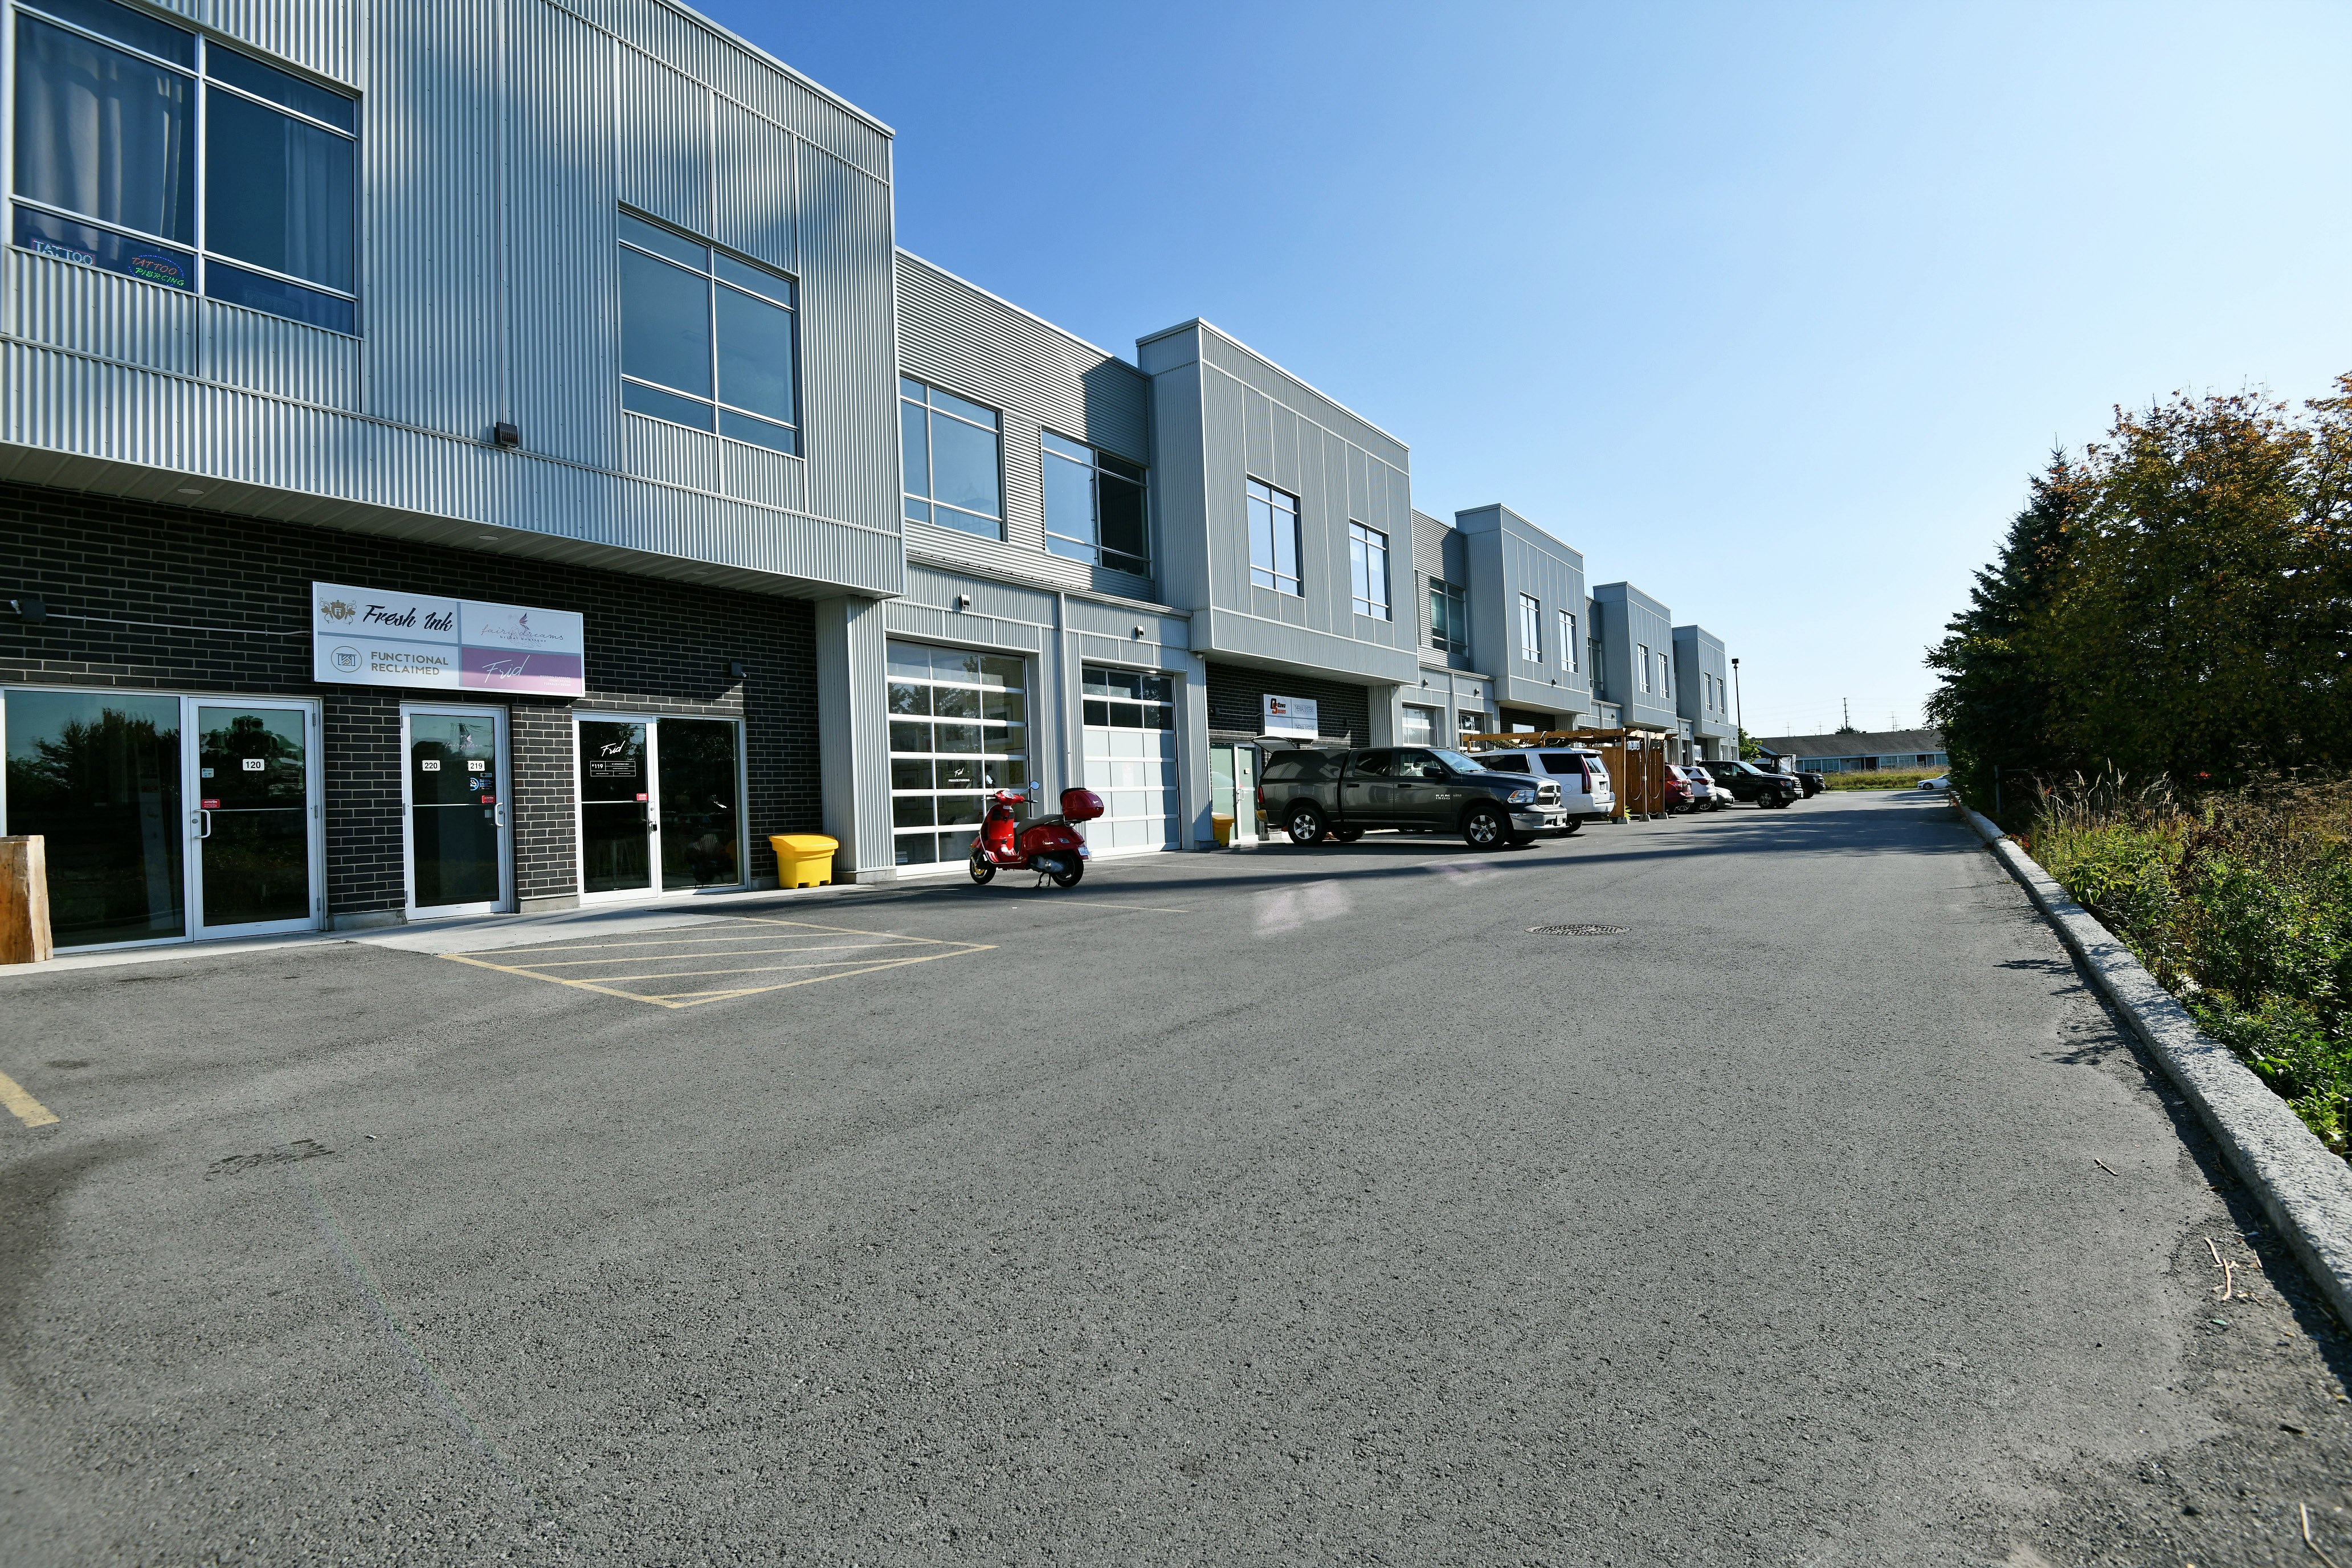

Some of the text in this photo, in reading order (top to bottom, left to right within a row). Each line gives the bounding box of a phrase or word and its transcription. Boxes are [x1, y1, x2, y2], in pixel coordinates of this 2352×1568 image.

[33, 239, 93, 266] TATTOO
[132, 257, 177, 276] TATTOO
[135, 267, 185, 286] PIERCING
[362, 605, 453, 631] Fresh Ink
[481, 624, 564, 640] fairy dreams
[371, 651, 448, 665] FUNCTIONAL
[371, 663, 440, 675] RECLAIMED
[481, 655, 530, 683] Frid
[444, 741, 464, 750] fairy
[600, 740, 626, 757] Frid
